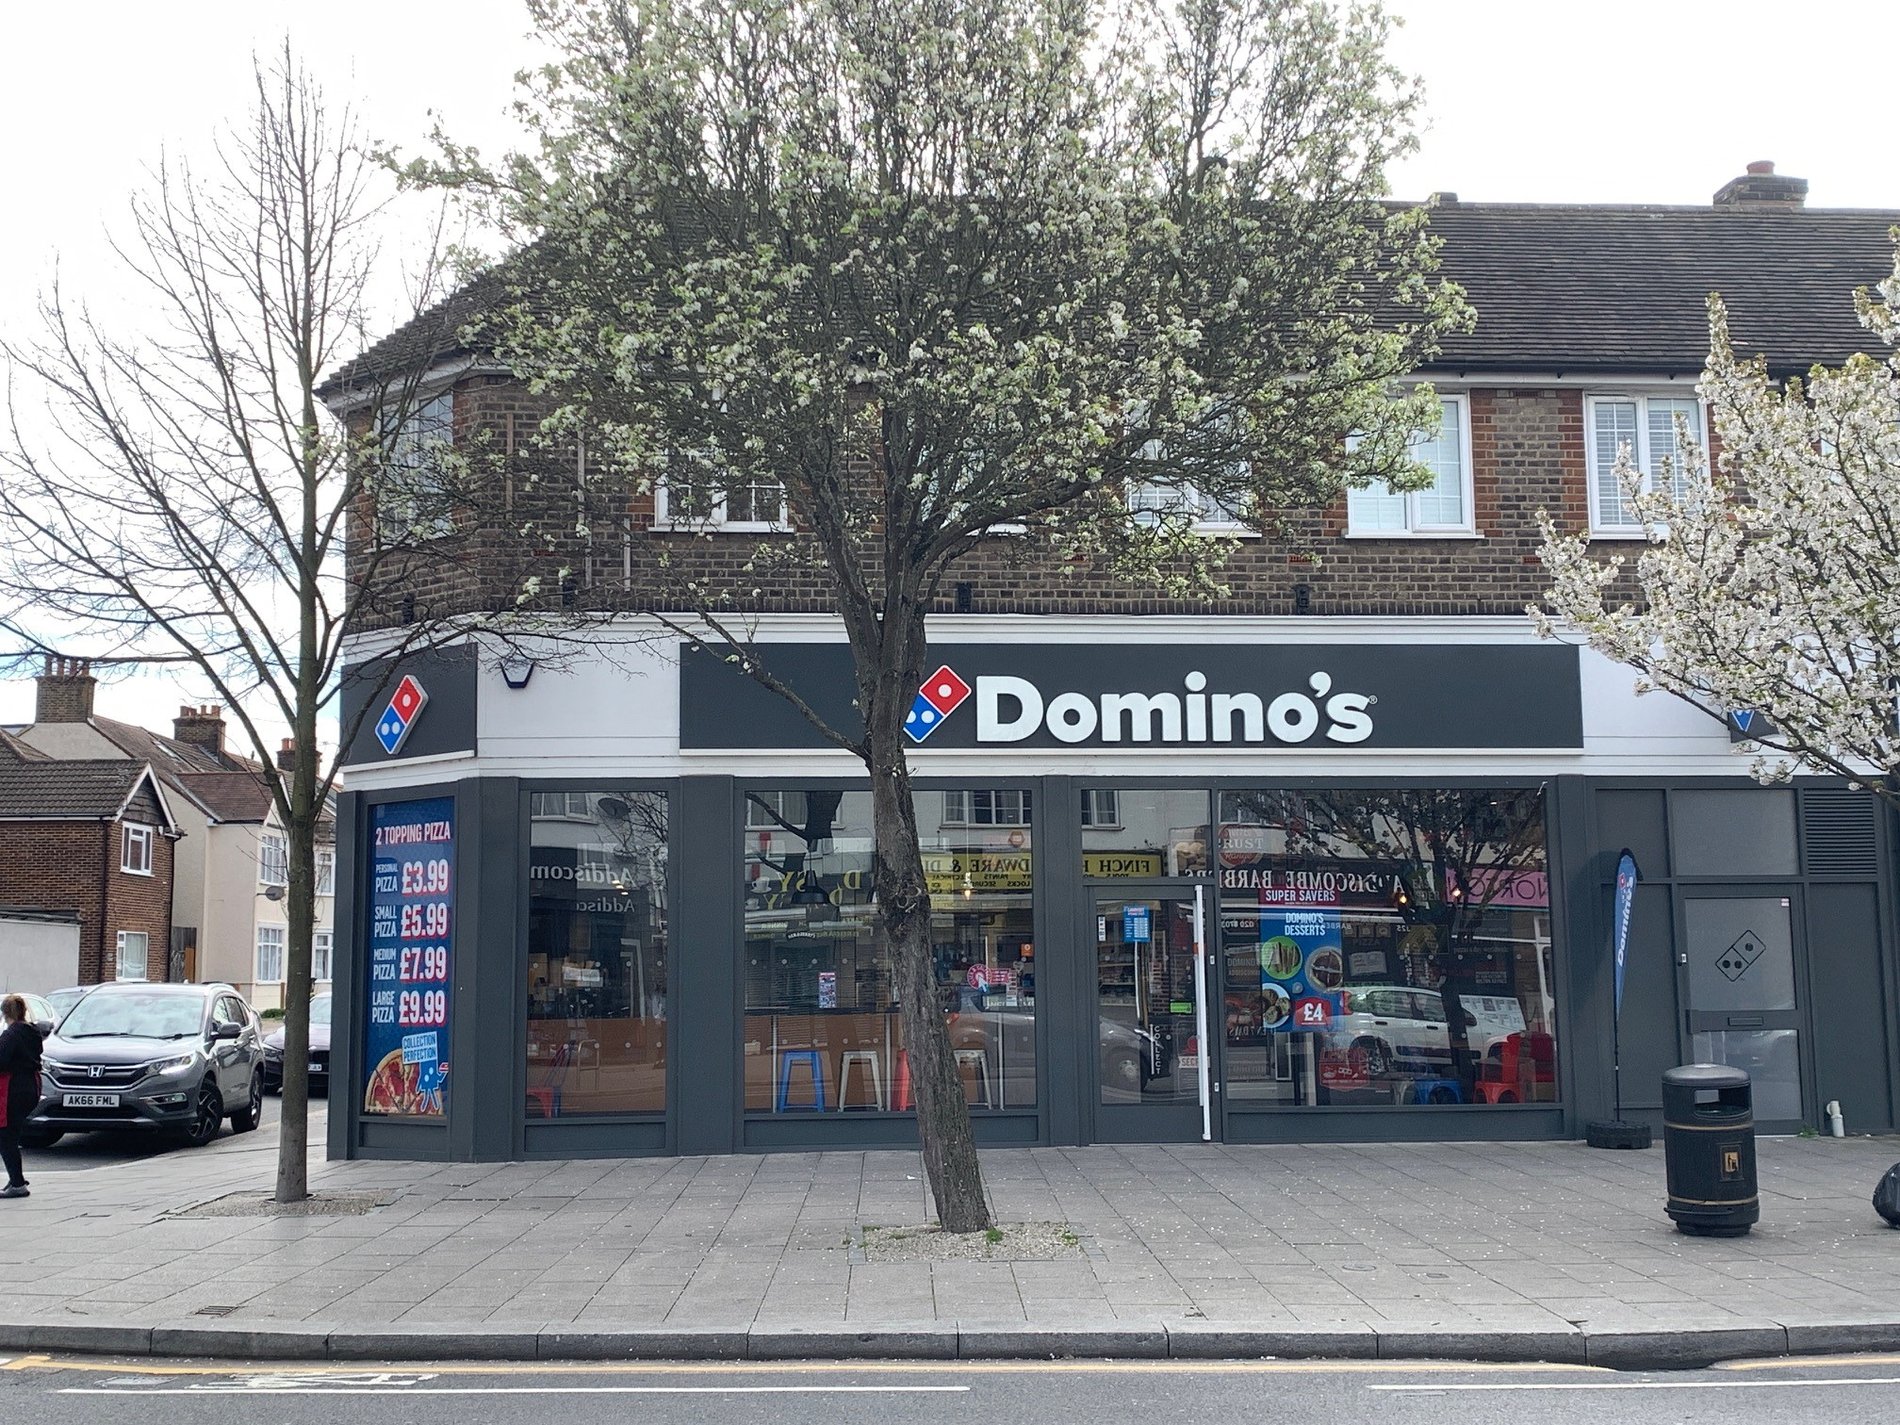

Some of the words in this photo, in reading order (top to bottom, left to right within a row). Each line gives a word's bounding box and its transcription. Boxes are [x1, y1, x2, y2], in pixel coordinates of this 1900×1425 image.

[976, 671, 1373, 743] Domino's
[375, 827, 382, 845] 2
[384, 824, 422, 845] TOPPING
[424, 821, 451, 841] PIZZA
[375, 863, 398, 873] PERSONAL
[402, 859, 449, 894] £3.99
[375, 876, 398, 893] PIZZA
[1265, 890, 1296, 901] SUPER
[1299, 890, 1336, 901] SAVERS
[375, 905, 397, 920] SMALL
[401, 902, 448, 937] £5.99
[1285, 912, 1324, 924] DOMINO'S
[374, 921, 397, 938] PIZZA
[1284, 925, 1326, 936] DESSERTS
[374, 947, 396, 961] MEDIUM
[373, 963, 396, 980] PIZZA
[399, 946, 447, 980] £7.99
[372, 991, 395, 1006] LARGE
[398, 990, 445, 1024] £9.99
[371, 1006, 395, 1023] PIZZA
[1303, 1002, 1323, 1022] £4
[403, 1035, 436, 1049] COLLECTION
[403, 1047, 436, 1062] PERFECTION
[68, 1096, 94, 1105] AK66
[96, 1096, 115, 1105] FML
